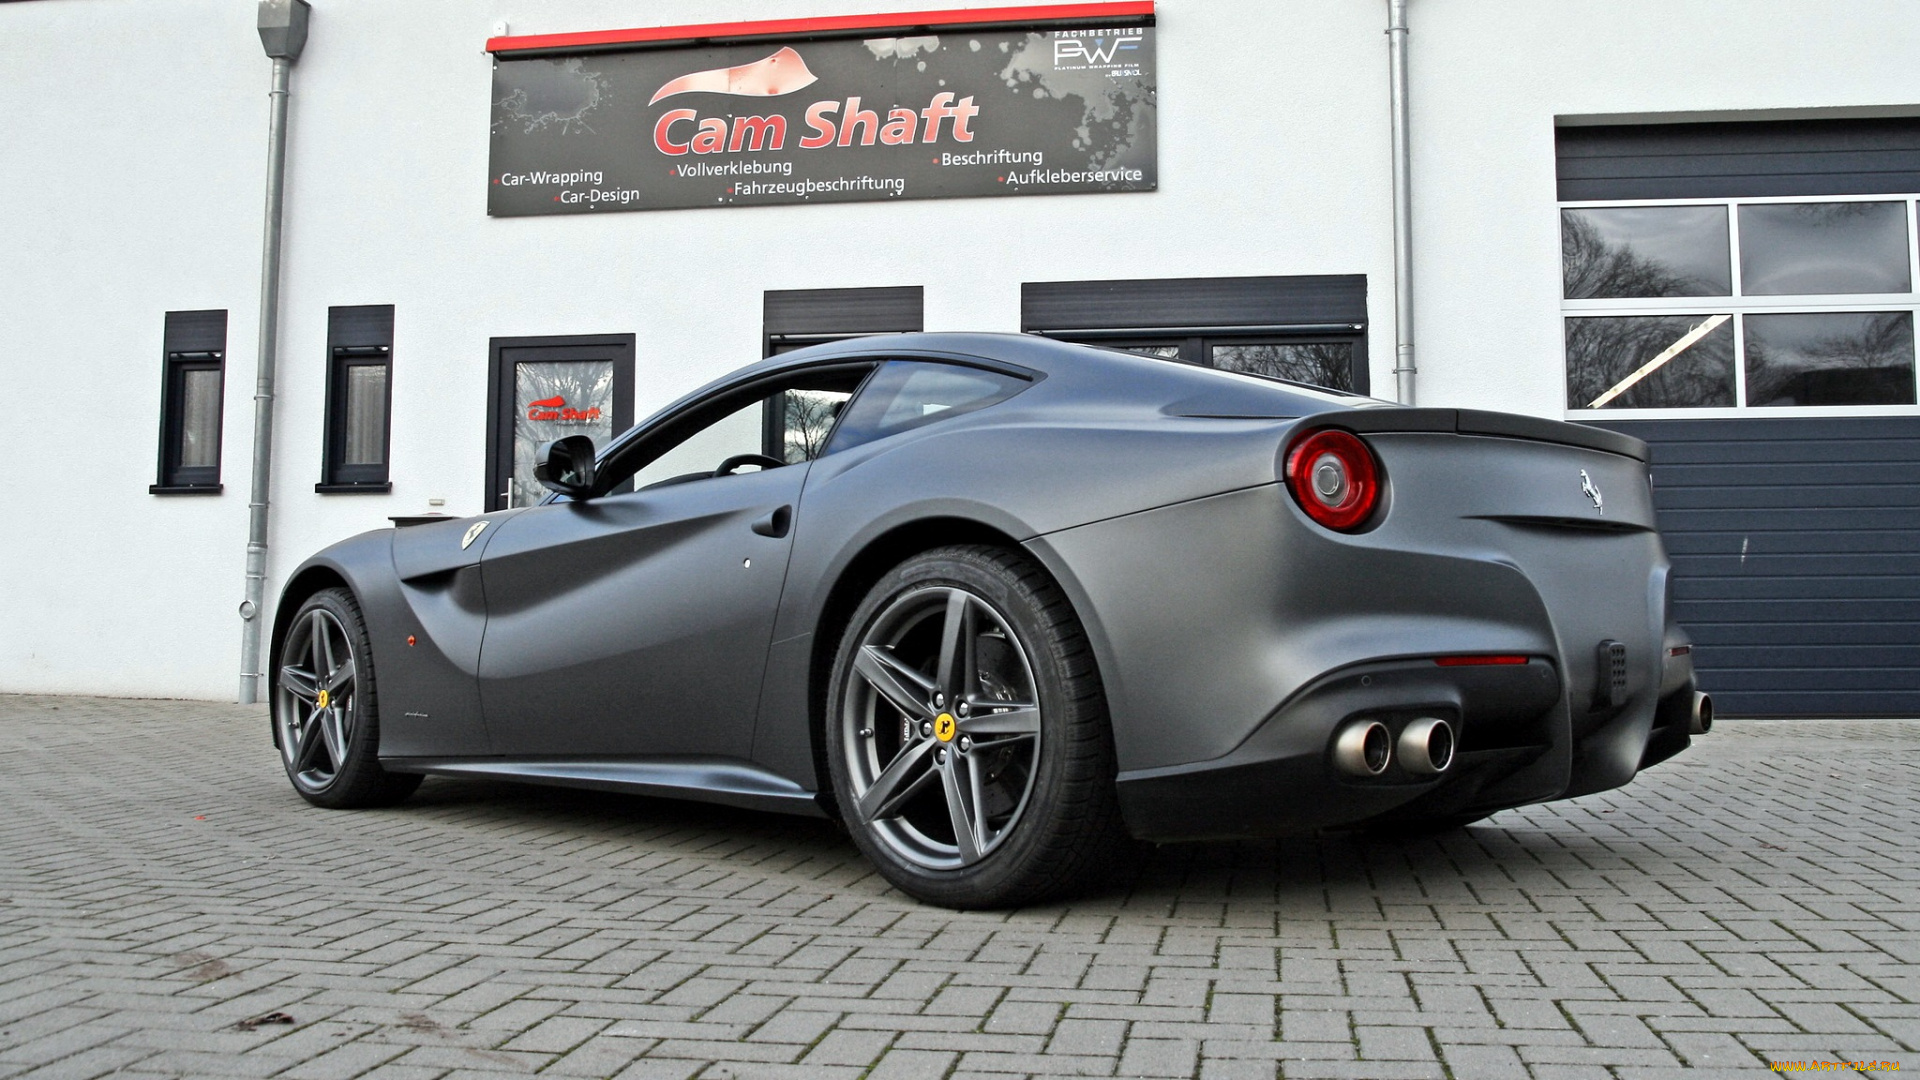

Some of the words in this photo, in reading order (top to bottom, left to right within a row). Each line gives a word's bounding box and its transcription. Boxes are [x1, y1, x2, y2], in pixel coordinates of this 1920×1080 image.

[1054, 28, 1143, 38] FACHBETRIEB
[653, 108, 787, 156] Cam
[798, 92, 980, 149] Shaft
[941, 149, 1044, 166] Beschriftung
[677, 160, 793, 178] Vollverklebung
[1006, 168, 1143, 185] Aufkleberservice
[501, 169, 603, 187] Car-Wrapping
[734, 176, 905, 196] Fahrzeugbeschriftung
[560, 188, 640, 204] Car-Design
[528, 408, 559, 421] Cam
[561, 406, 601, 421] Shaft
